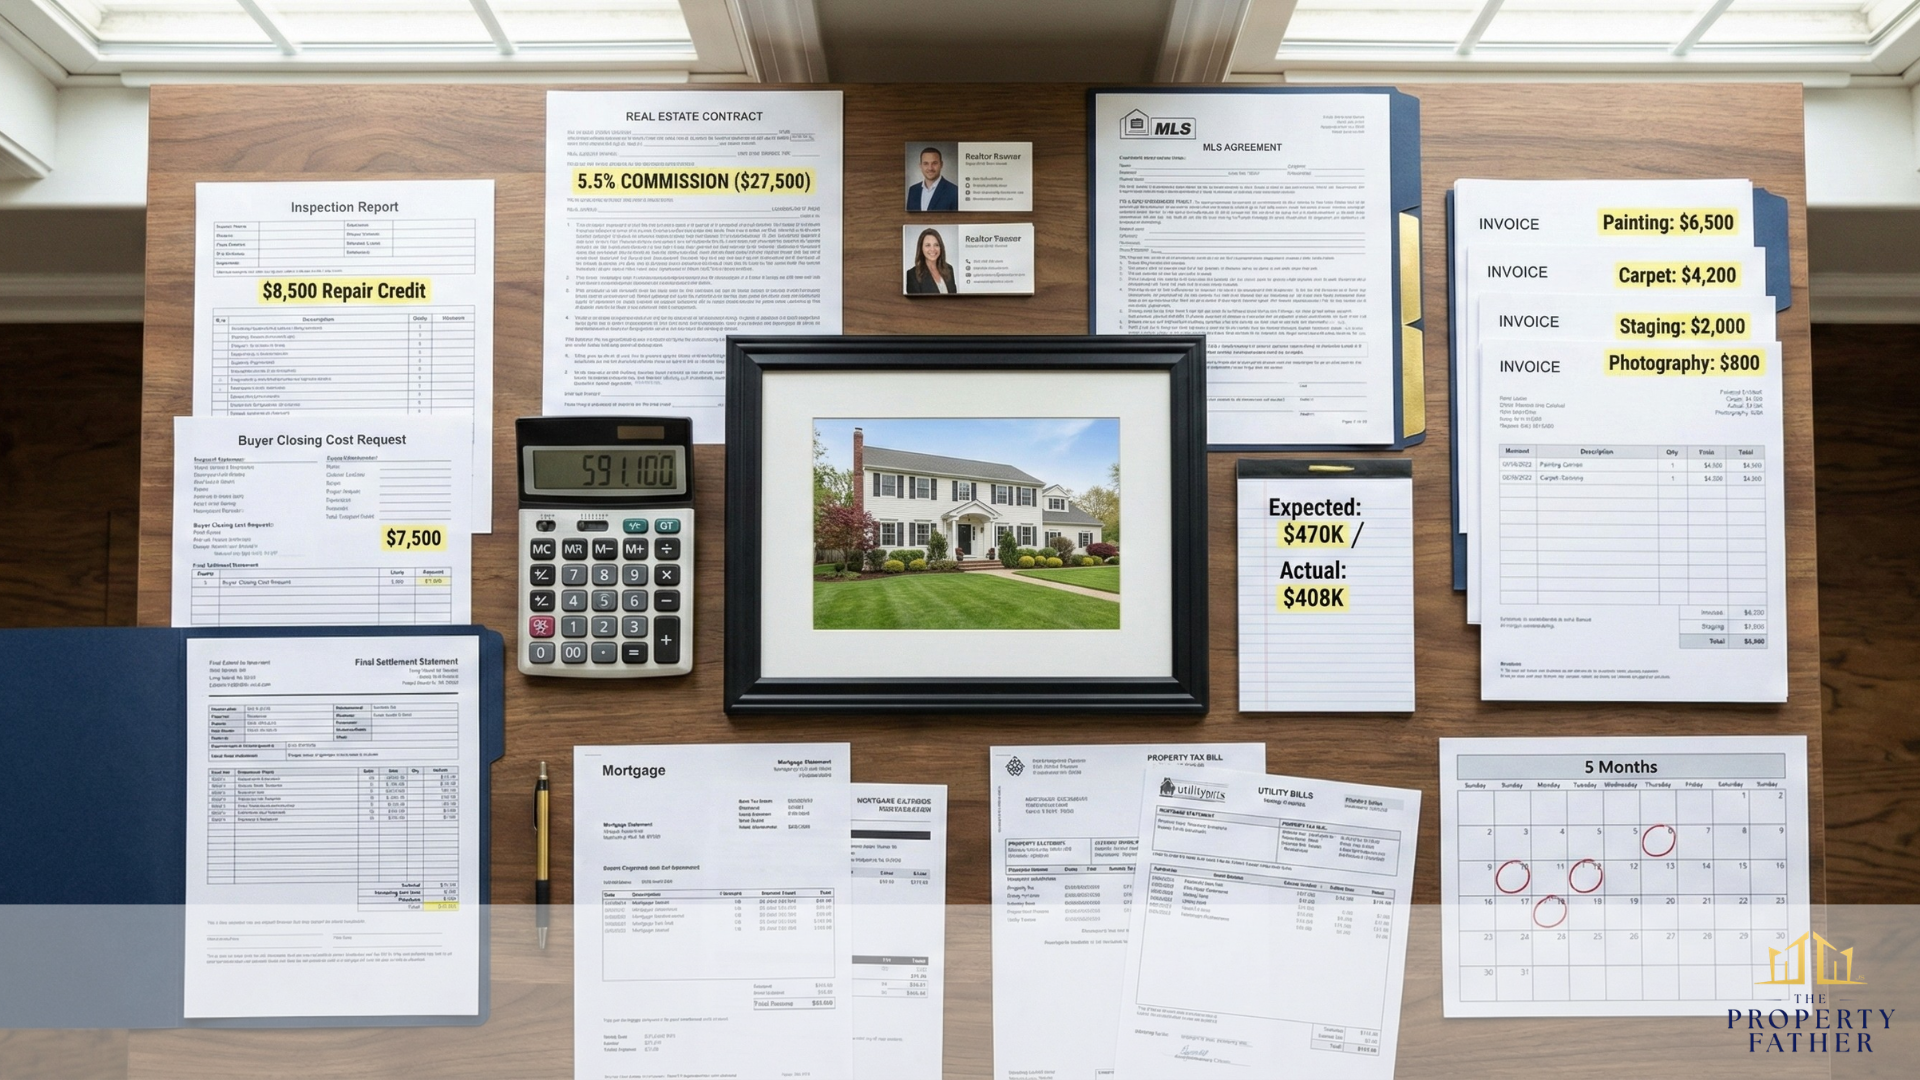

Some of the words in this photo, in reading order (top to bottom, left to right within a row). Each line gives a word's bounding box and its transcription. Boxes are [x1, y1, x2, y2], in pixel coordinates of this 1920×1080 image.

[626, 112, 655, 121] REAL
[659, 112, 699, 121] ESTATE
[703, 112, 763, 121] CONTRACT
[1155, 123, 1191, 135] MLS
[1203, 143, 1222, 151] MLS
[1224, 143, 1282, 151] AGREEMENT
[578, 173, 615, 189] 5.5%
[621, 173, 728, 189] COMMISSION
[735, 171, 810, 193] ($27,500)
[292, 202, 354, 215] Inspection
[359, 201, 398, 215] Report
[1480, 218, 1539, 230] INVOICE
[1604, 214, 1674, 234] Painting:
[1680, 213, 1733, 233] $6,500
[1488, 266, 1548, 278] INVOICE
[1619, 267, 1676, 287] Carpet:
[1682, 266, 1736, 286] $4,200
[263, 281, 317, 302] $8,500
[323, 282, 373, 303] Repair
[378, 282, 426, 298] Credit
[1500, 315, 1559, 327] INVOICE
[1620, 318, 1685, 338] Staging:
[1691, 317, 1745, 337] $2,000
[1501, 360, 1560, 373] INVOICE
[1610, 354, 1714, 375] Photography:
[1720, 353, 1759, 372] $800
[239, 435, 273, 448] Buyer
[277, 435, 322, 448] Closing
[326, 435, 353, 445] Cost
[358, 434, 406, 447] Request
[1270, 497, 1361, 520] Expected:
[387, 528, 441, 549] $7,500
[1284, 523, 1344, 545] $470K
[533, 544, 550, 554] MC
[626, 544, 644, 553] M+
[570, 569, 578, 580] 7
[600, 569, 608, 580] 8
[631, 569, 638, 581] 9
[1280, 560, 1346, 579] Actual:
[569, 595, 577, 606] 4
[601, 596, 608, 606] 5
[631, 595, 638, 607] 6
[1284, 586, 1344, 609] $408K
[571, 621, 575, 632] 1
[600, 621, 607, 632] 2
[631, 621, 638, 632] 3
[537, 647, 545, 658] 0
[566, 647, 581, 658] 00
[355, 658, 374, 666] Final
[376, 658, 417, 666] Settlement
[603, 765, 665, 779] Mortgage
[1585, 761, 1594, 773] 5
[1599, 760, 1657, 773] Months
[1258, 787, 1288, 796] UTILITY
[1290, 790, 1313, 799] BILLS
